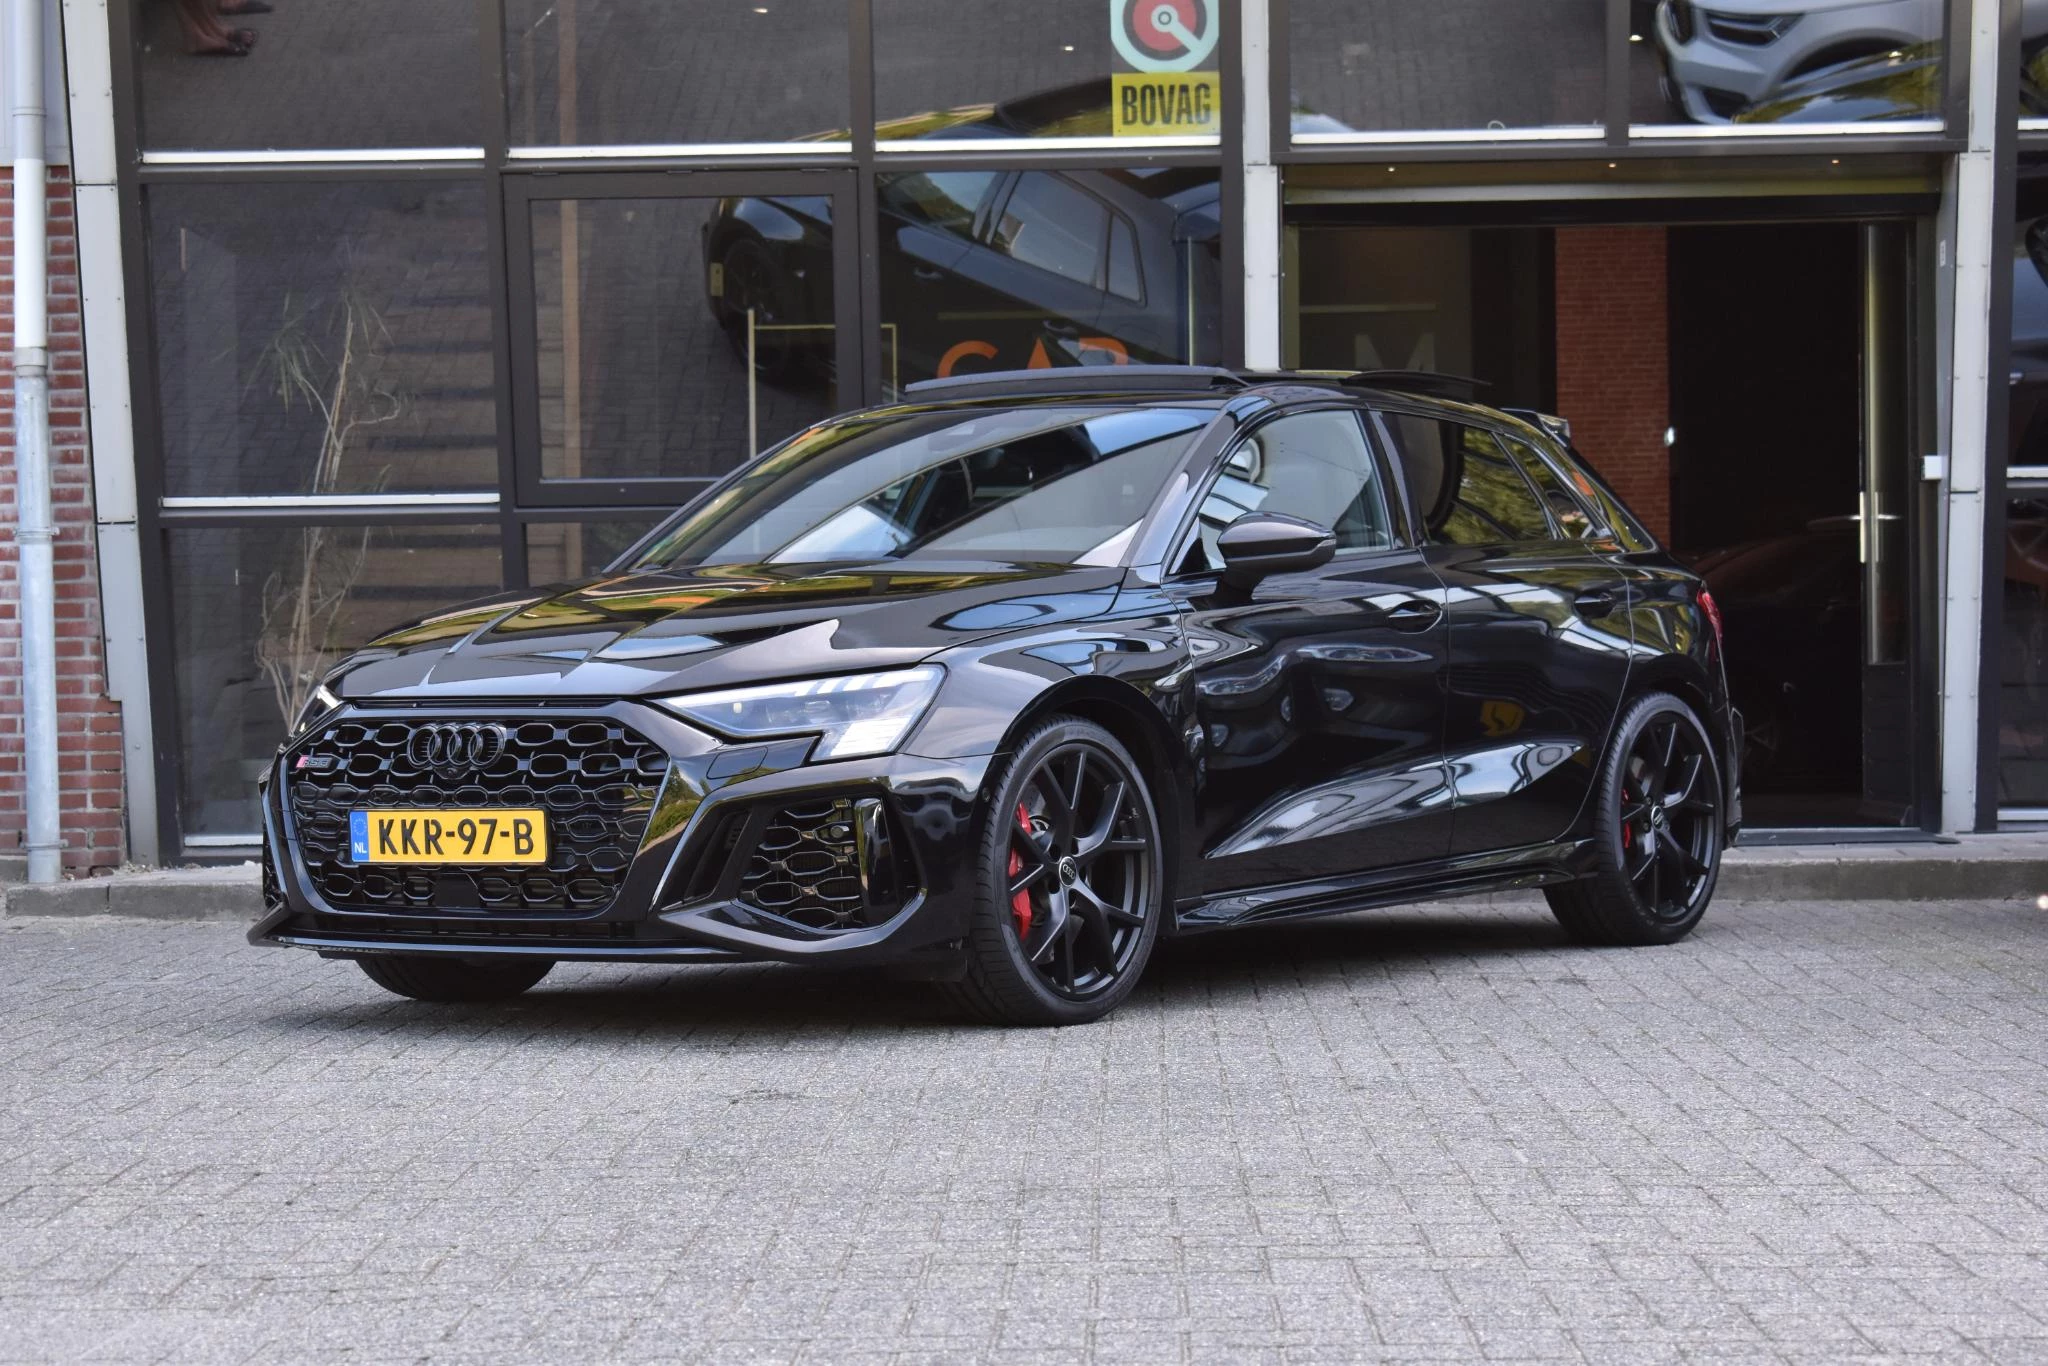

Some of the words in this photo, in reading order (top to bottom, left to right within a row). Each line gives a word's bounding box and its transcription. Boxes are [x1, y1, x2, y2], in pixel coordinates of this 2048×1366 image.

[1121, 83, 1211, 126] BOVAG
[354, 841, 368, 854] NL
[378, 818, 535, 856] KKR-97-B
